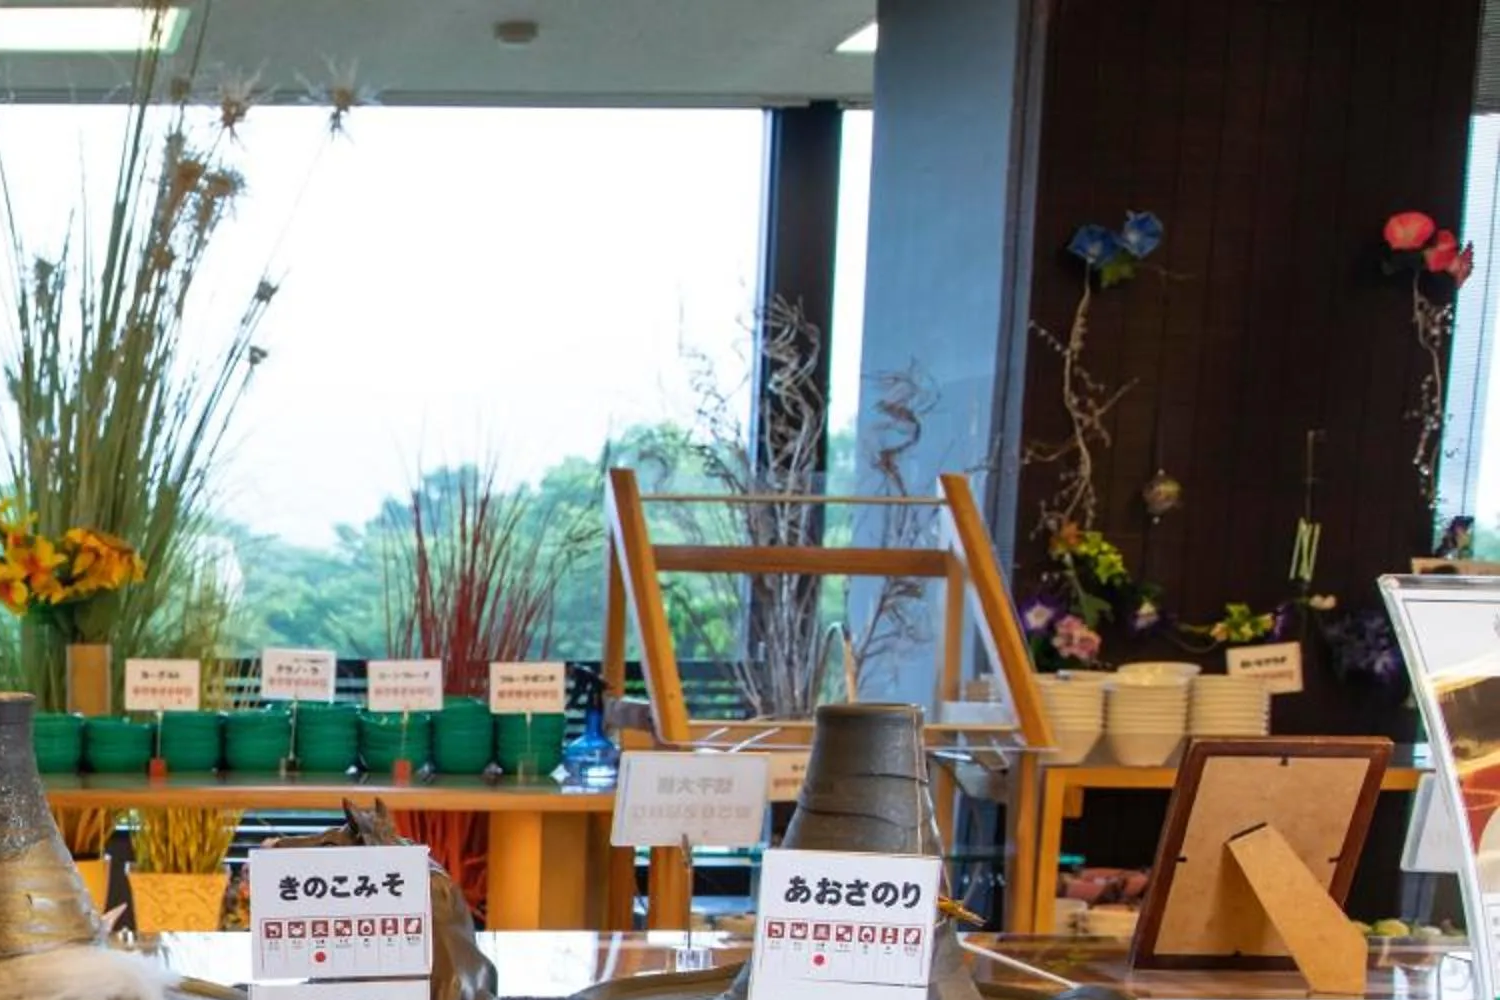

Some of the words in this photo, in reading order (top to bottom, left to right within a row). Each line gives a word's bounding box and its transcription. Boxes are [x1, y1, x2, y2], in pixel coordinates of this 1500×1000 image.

[278, 872, 405, 901] きのこみそ
[784, 875, 921, 909] あおさのり
